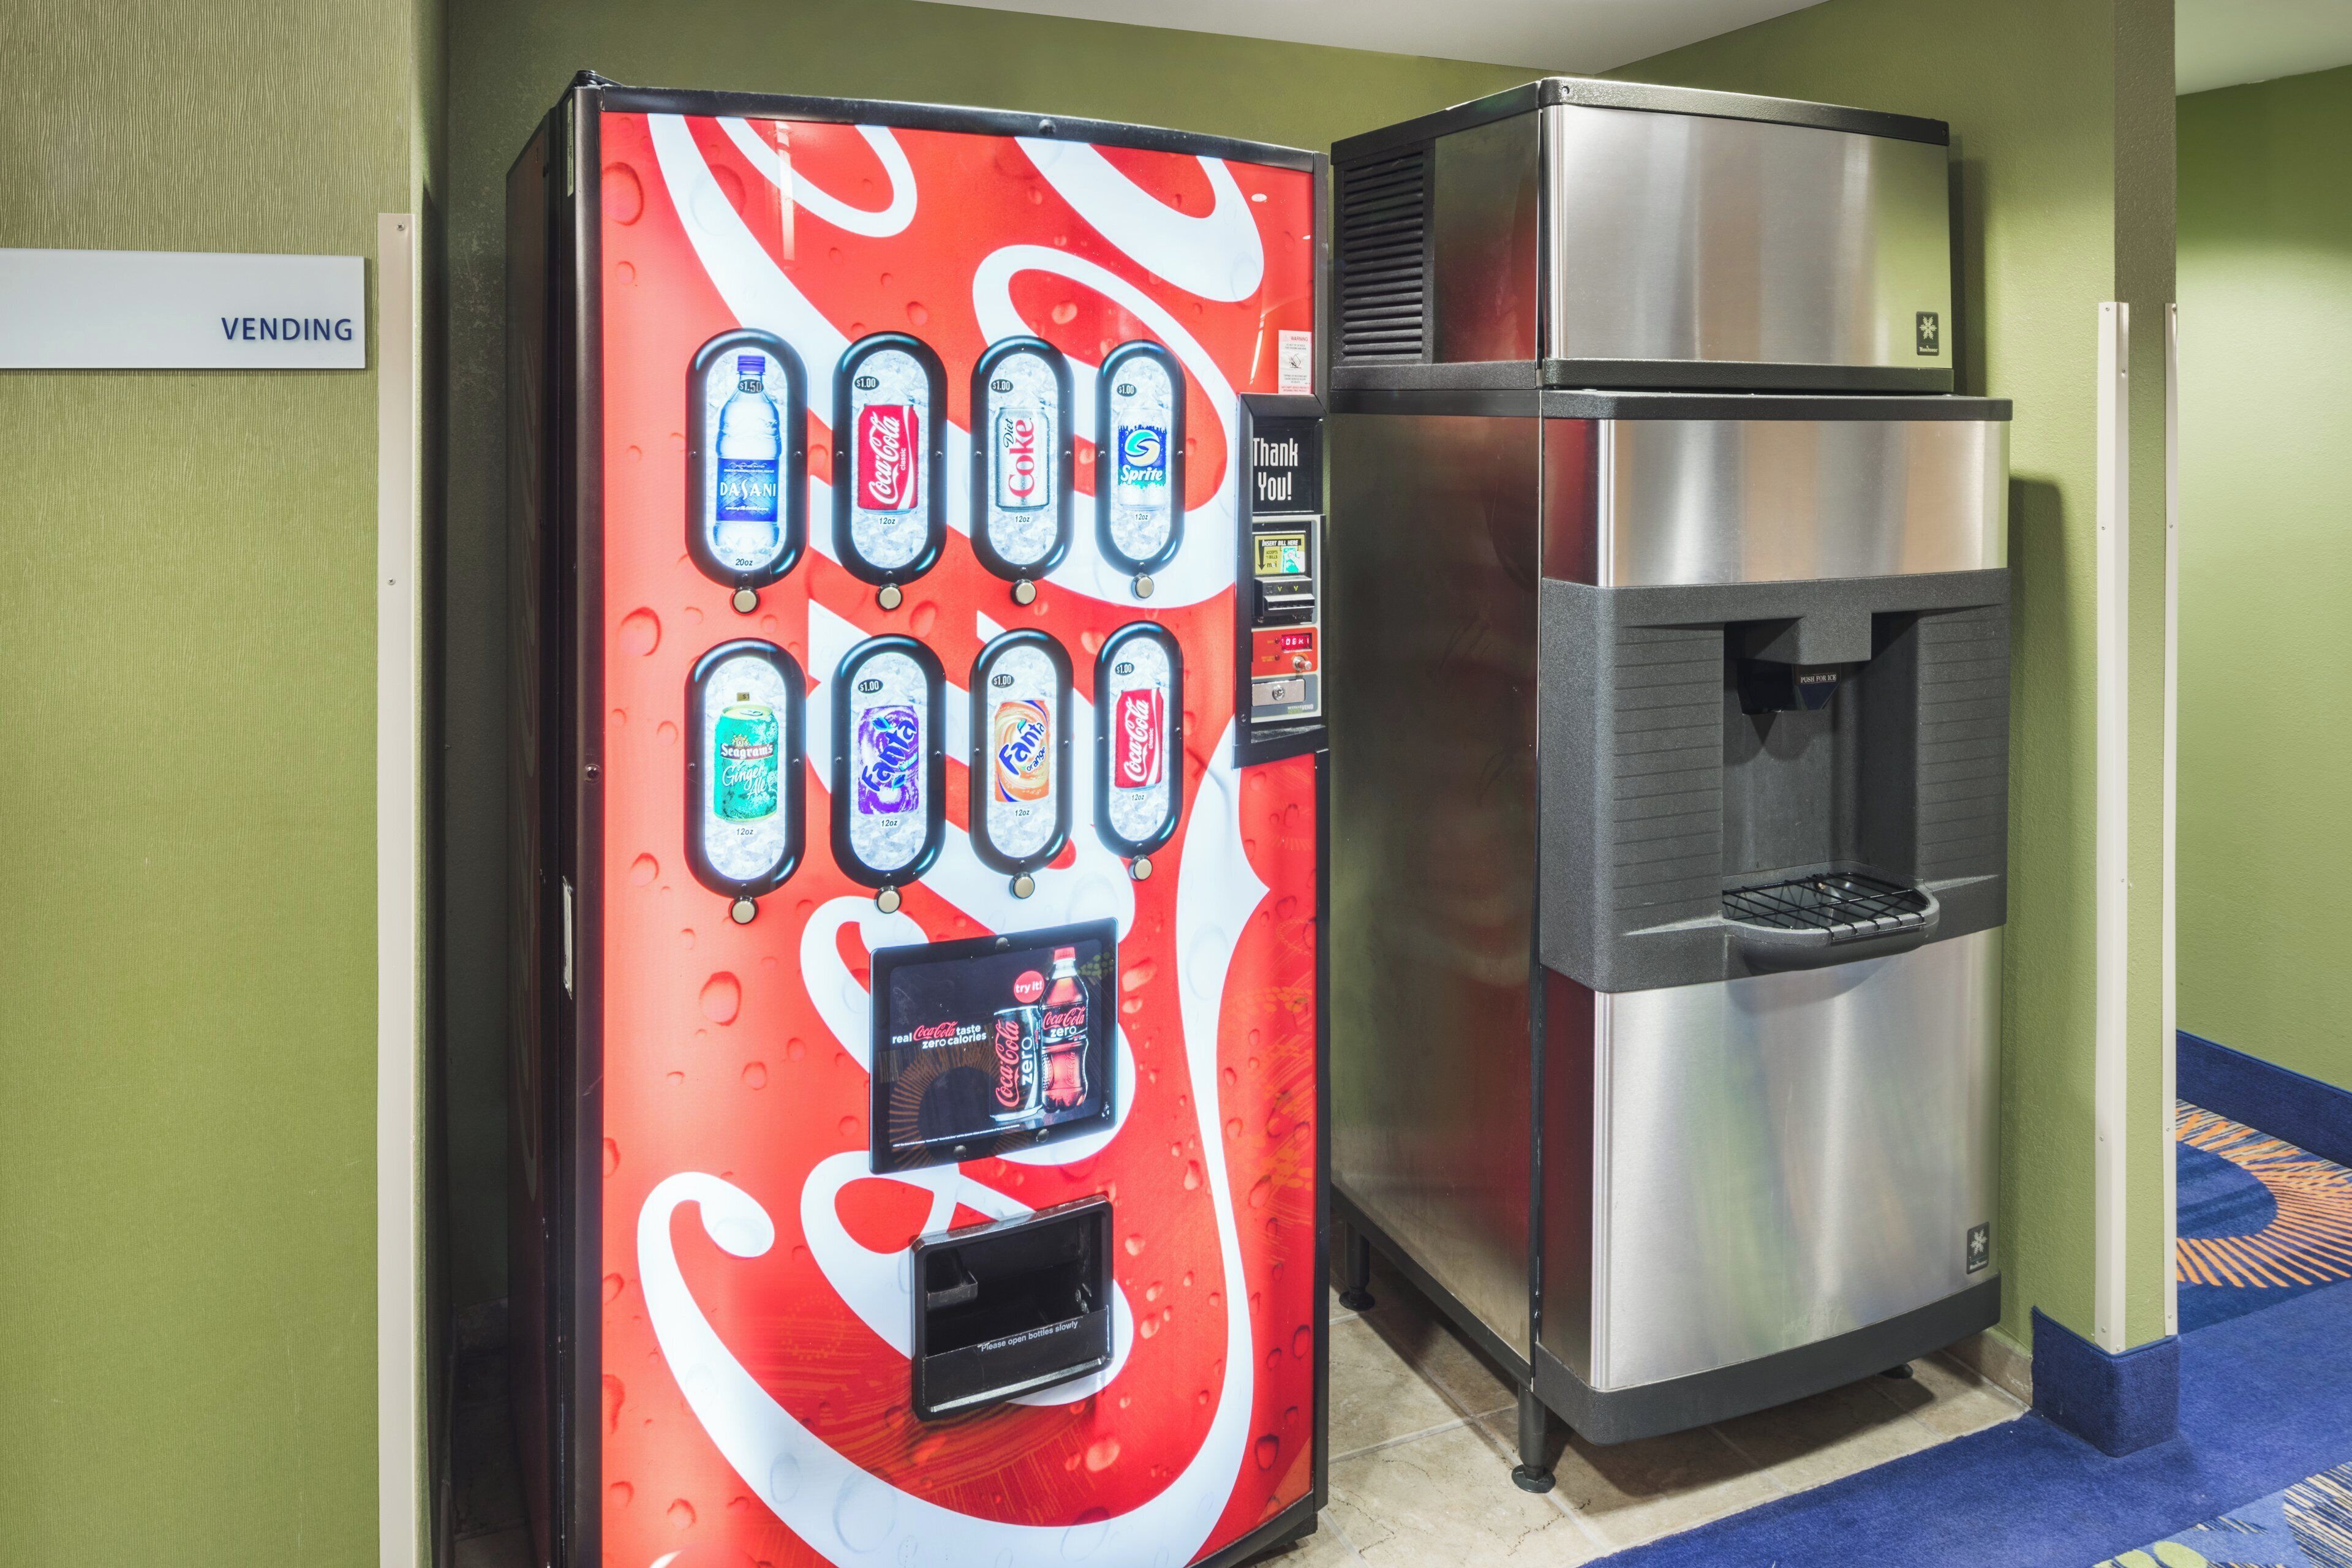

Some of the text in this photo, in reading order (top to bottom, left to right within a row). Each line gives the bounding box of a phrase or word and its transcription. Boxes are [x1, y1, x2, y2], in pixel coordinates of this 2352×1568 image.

[221, 317, 352, 341] VENDING
[739, 381, 762, 393] $1.50
[856, 378, 876, 388] $1.00
[992, 381, 1010, 390] $1.00
[1118, 385, 1134, 394] $1.00
[1003, 418, 1014, 448] Diet
[869, 411, 900, 504] Coca-Cola
[1008, 419, 1035, 497] Coke
[1253, 437, 1298, 466] Thank
[1120, 464, 1163, 484] Sprite
[1258, 471, 1292, 500] You!
[720, 478, 776, 500] DASANI
[993, 676, 1011, 685] $1.00
[1117, 664, 1132, 674] $1.00
[859, 680, 879, 691] $1.00
[999, 722, 1045, 776] Fanta
[1123, 696, 1149, 782] Coca-Cola
[721, 742, 774, 760] Seagram's
[861, 719, 917, 792] Fanta
[1027, 746, 1046, 772] orange
[722, 764, 767, 791] Ginger
[747, 778, 766, 799] Ale
[1016, 981, 1042, 993] try it!
[1043, 1006, 1086, 1030] Coca-Cola
[892, 1021, 981, 1044] real Coca-Cola taste
[922, 1032, 987, 1049] zero calories
[1050, 1026, 1076, 1038] zero
[995, 1019, 1019, 1107] Coca-Cola
[1022, 1036, 1033, 1085] zero
[981, 1321, 1078, 1352] Please open bottles slowly
